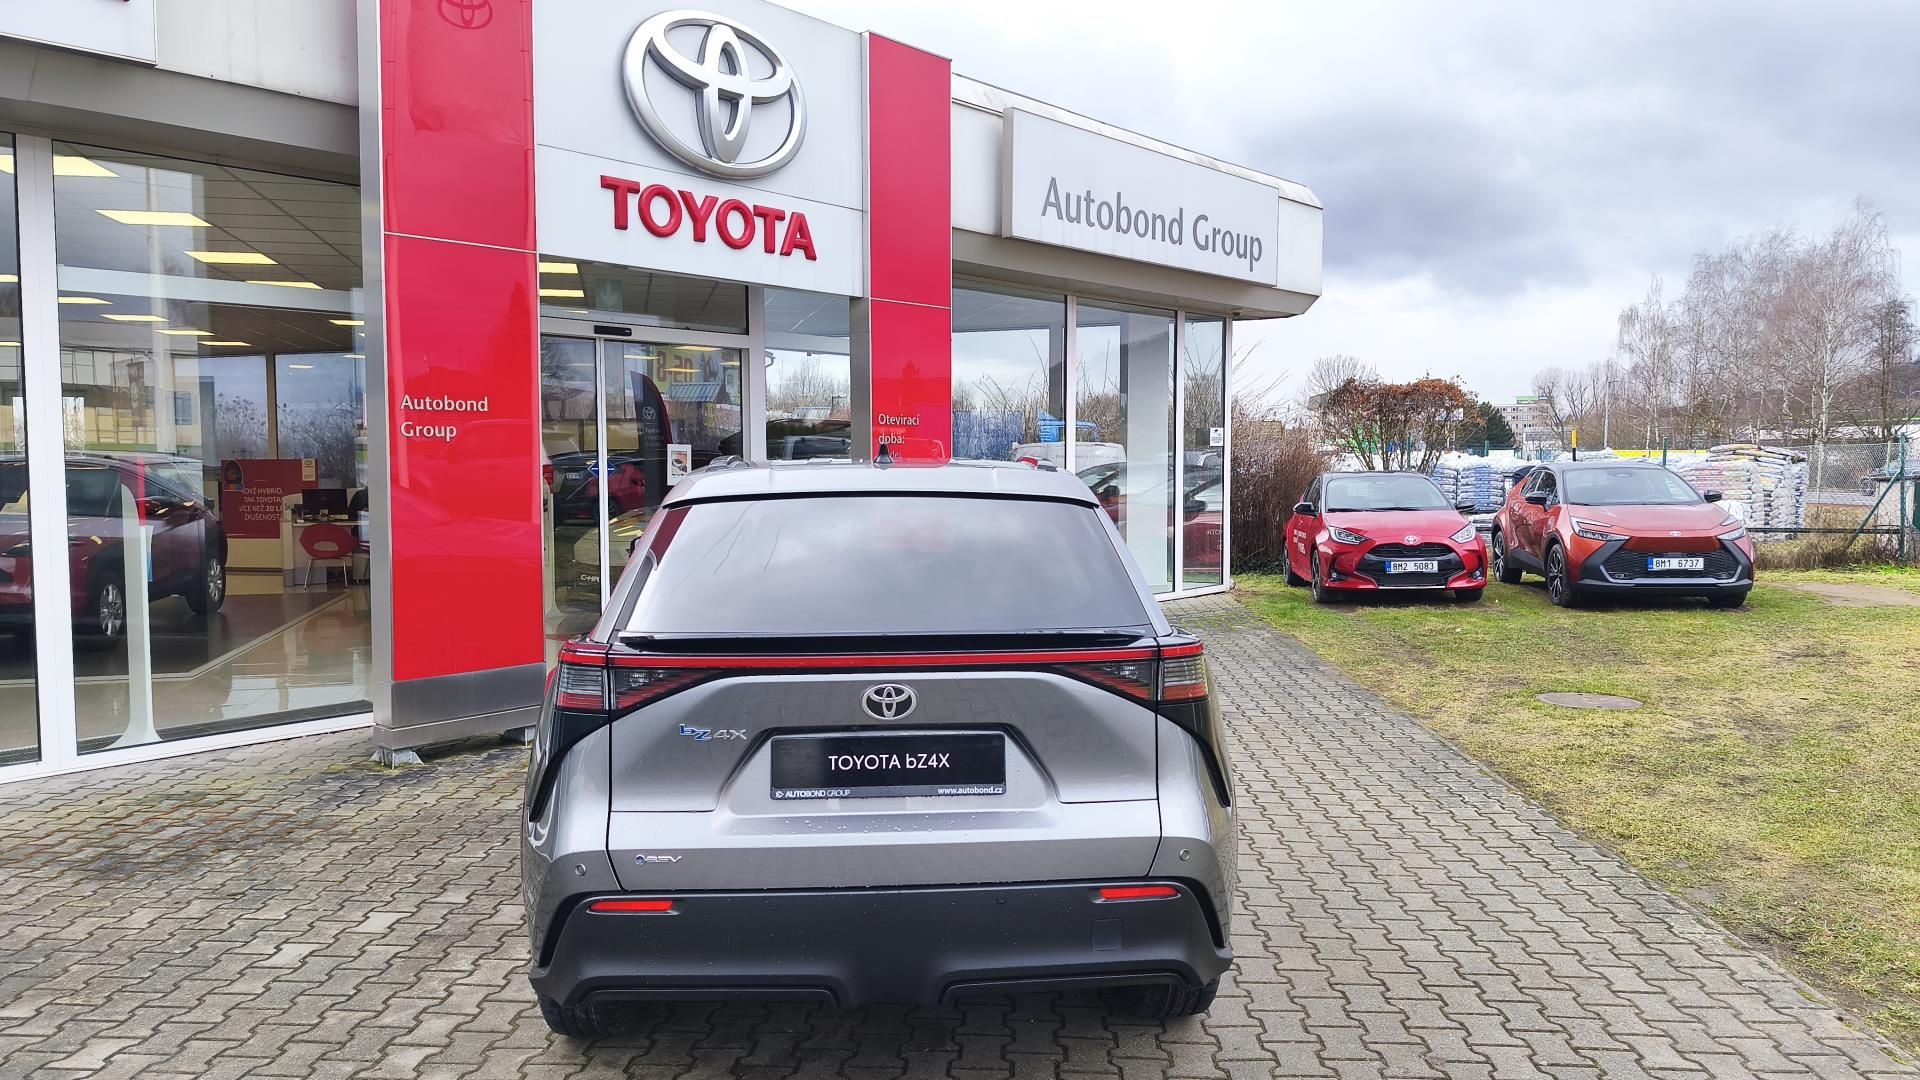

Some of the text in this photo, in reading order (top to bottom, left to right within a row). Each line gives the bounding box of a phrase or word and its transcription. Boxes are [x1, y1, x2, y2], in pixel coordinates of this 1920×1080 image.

[601, 175, 817, 261] TOYOTA
[1041, 177, 1263, 272] Autobond Group
[400, 394, 488, 412] Autobond
[878, 413, 920, 426] Otevírací
[400, 421, 457, 442] Group
[878, 432, 905, 444] doba:
[1393, 562, 1434, 571] 8M2 5083
[1678, 559, 1700, 568] 6737
[828, 753, 950, 771] TOYOTA bZ4X
[785, 786, 1003, 798] AUTOBOND GROUP www.autobond.cz
